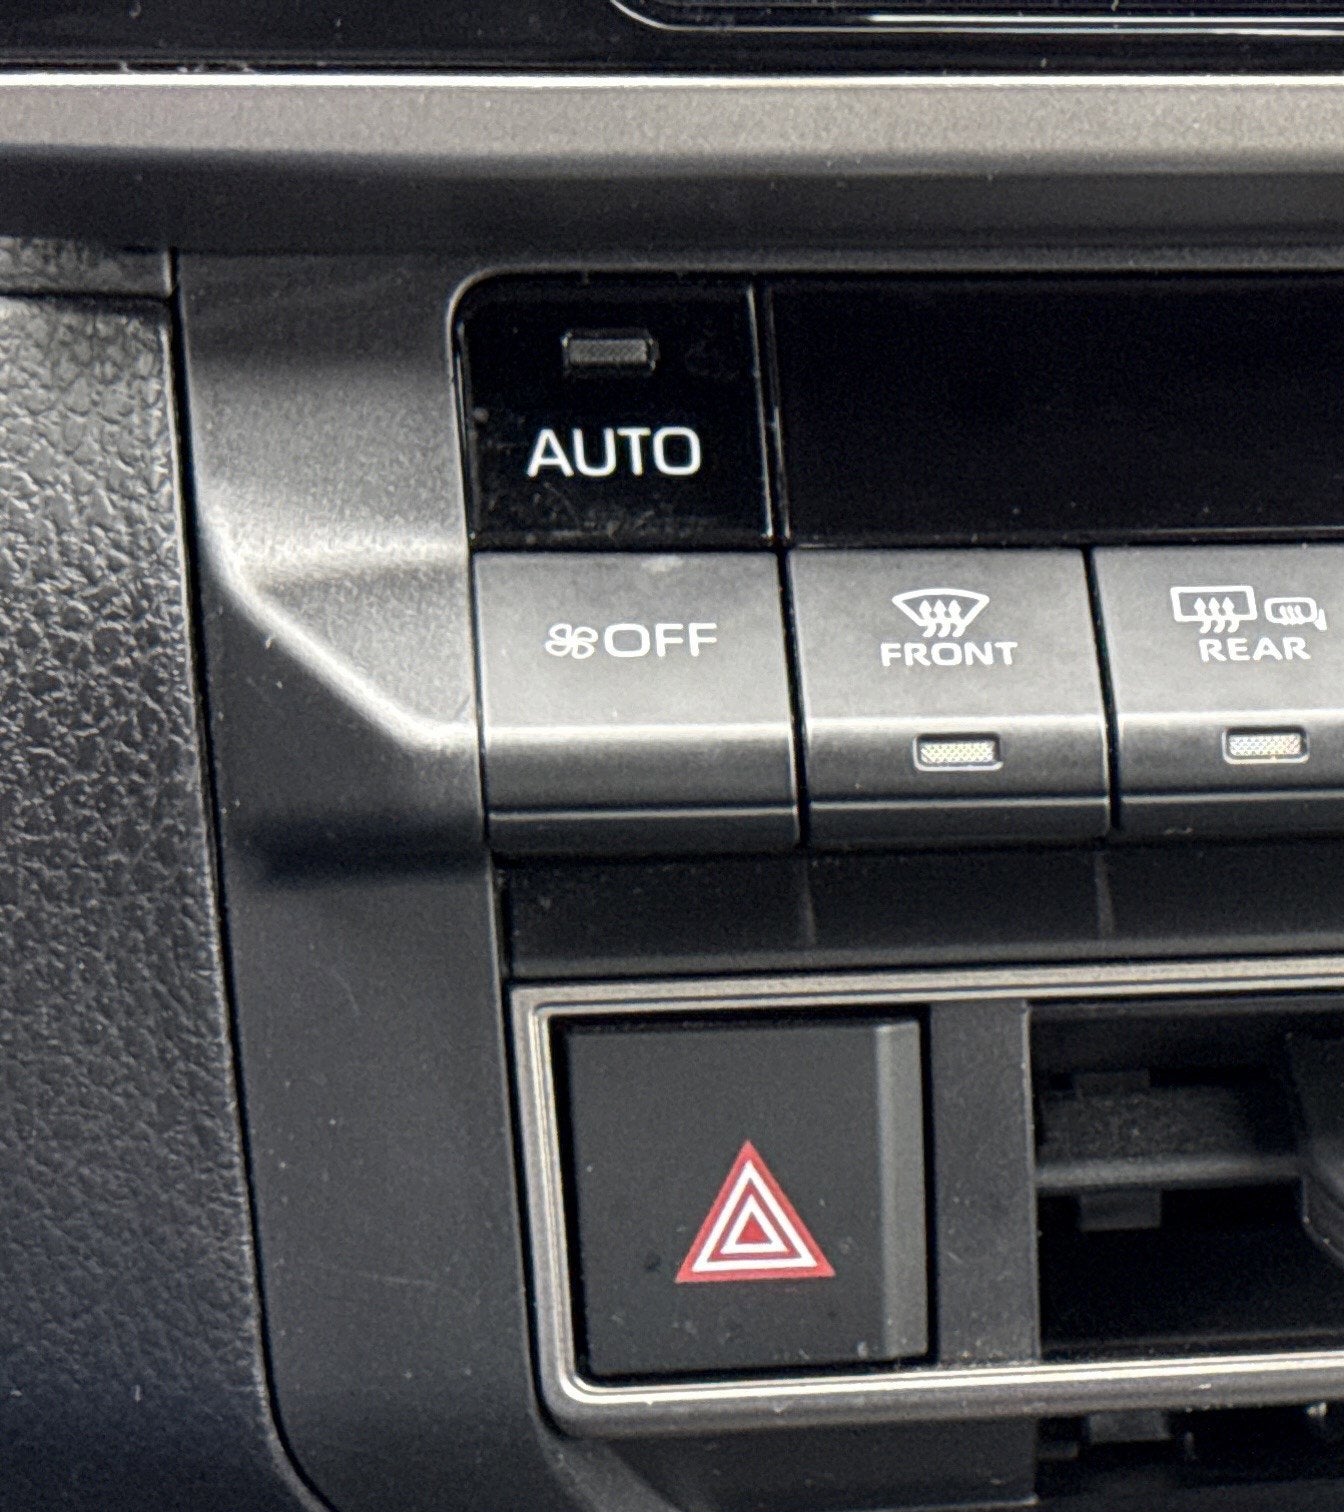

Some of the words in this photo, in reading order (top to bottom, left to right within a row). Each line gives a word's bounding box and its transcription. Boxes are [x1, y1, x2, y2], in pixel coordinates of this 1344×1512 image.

[526, 426, 702, 478] AUTO
[602, 621, 719, 659] OFF
[879, 640, 1019, 668] FRONT
[1197, 635, 1313, 664] REAR
